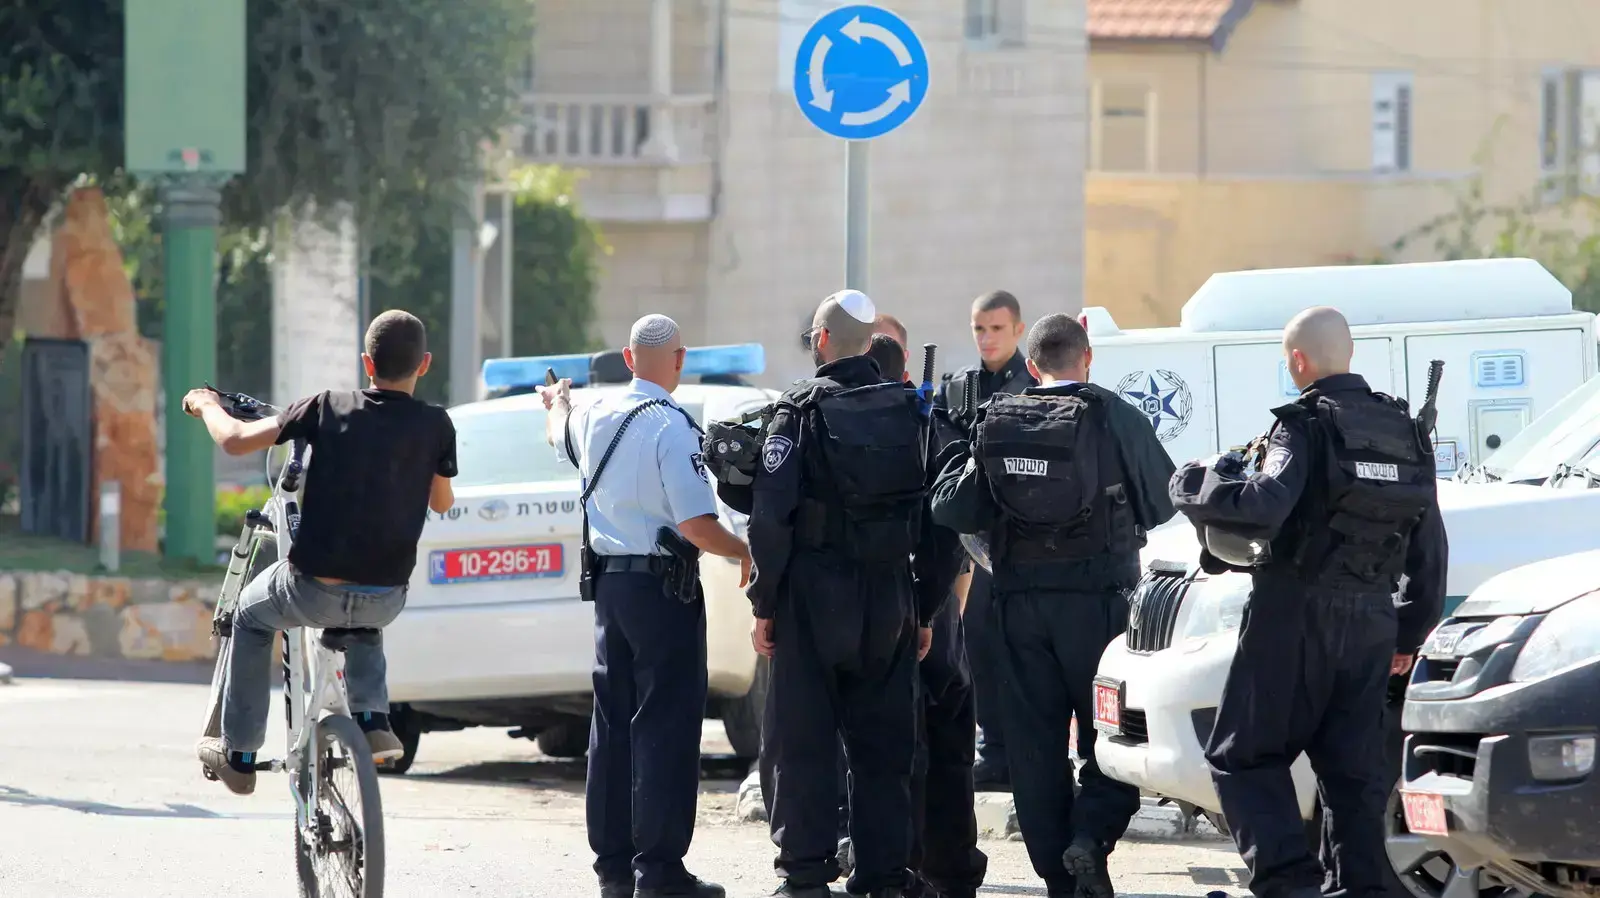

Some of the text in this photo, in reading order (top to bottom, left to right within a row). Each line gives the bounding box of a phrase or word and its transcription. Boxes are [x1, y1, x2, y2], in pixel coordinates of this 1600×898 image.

[1006, 458, 1046, 474] משטרה
[1358, 462, 1397, 478] משטרה
[517, 501, 581, 516] שטרת
